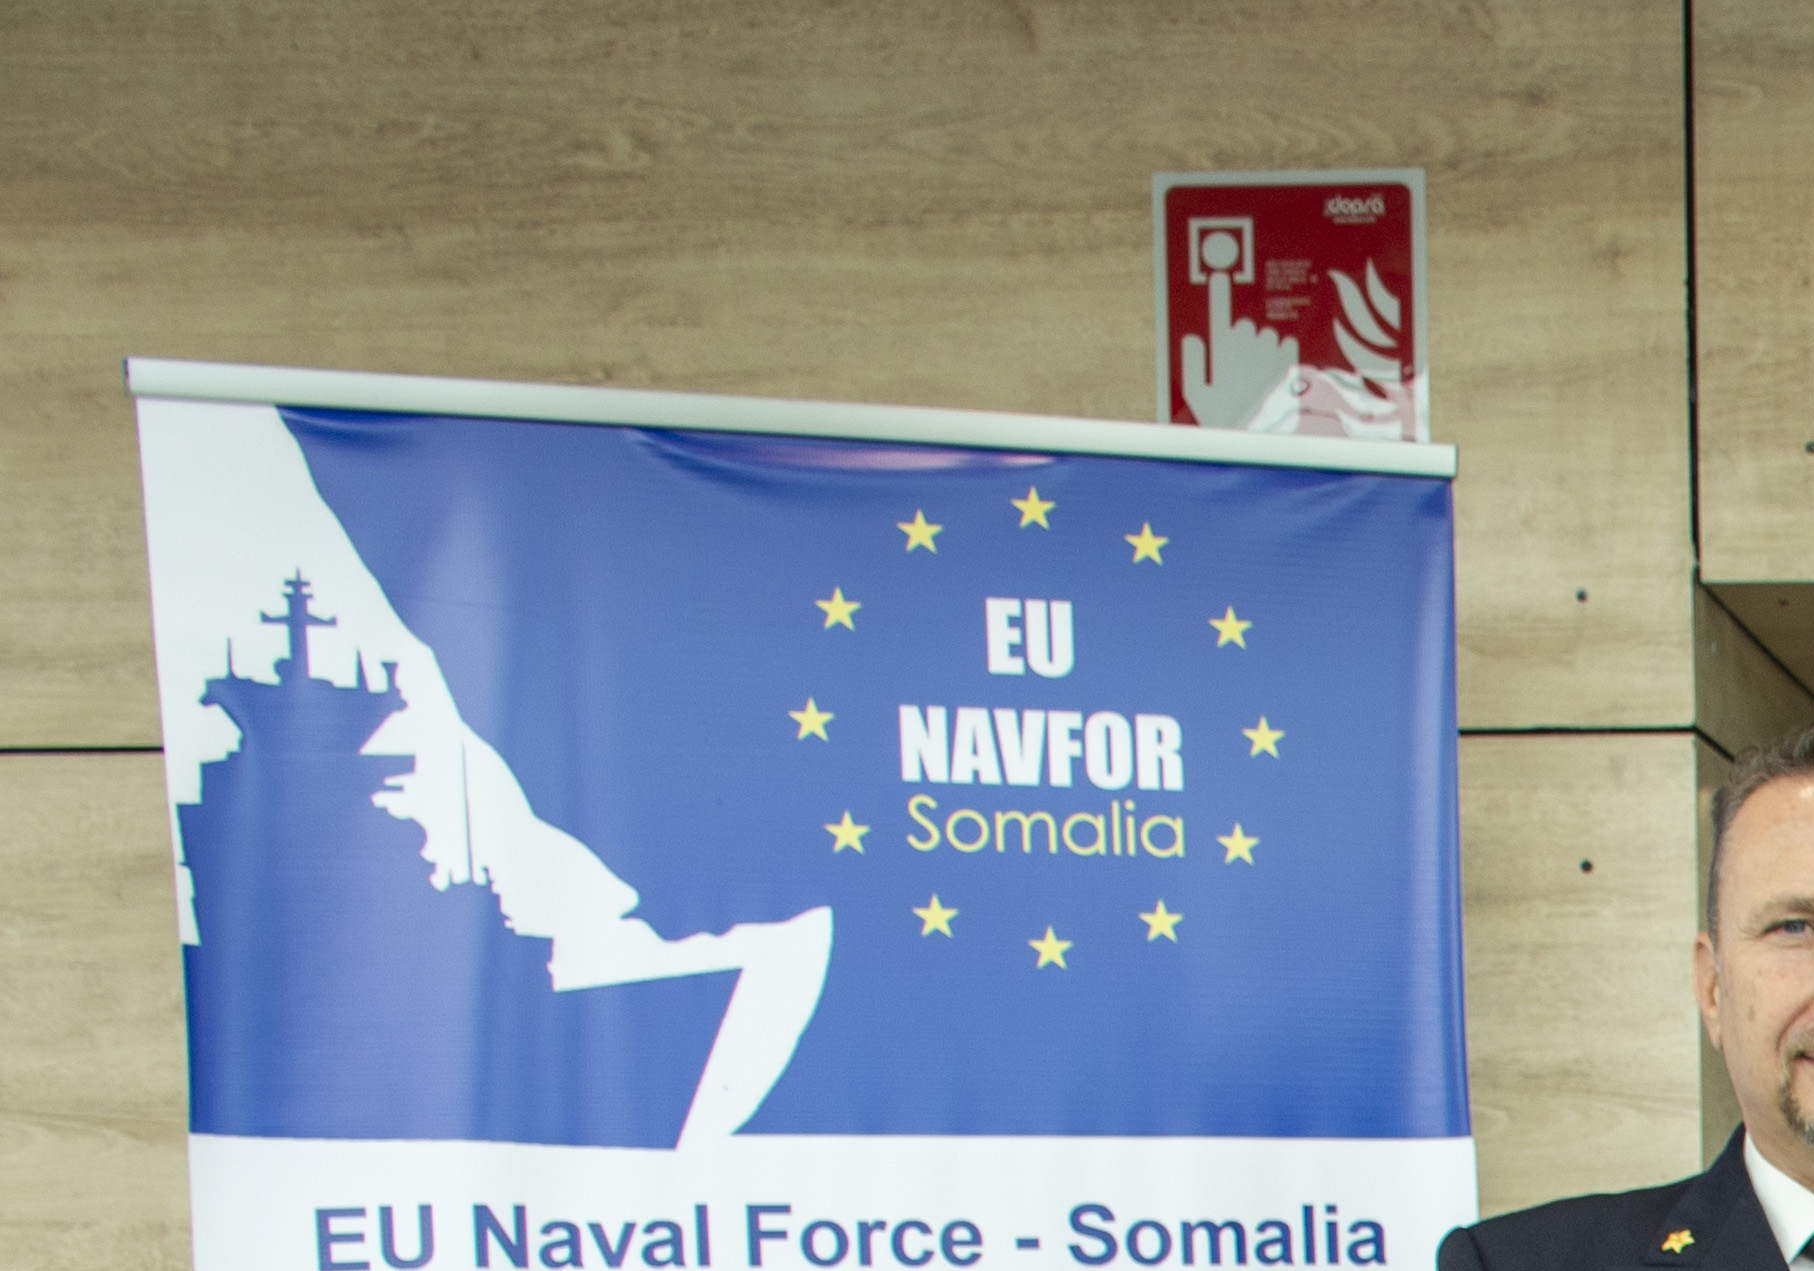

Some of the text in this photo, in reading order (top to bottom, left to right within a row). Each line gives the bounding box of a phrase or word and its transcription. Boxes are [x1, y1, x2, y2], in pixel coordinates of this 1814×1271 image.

[984, 596, 1075, 679] EU
[898, 704, 1184, 791] NAVFOR
[906, 794, 1186, 859] Somalia
[472, 1203, 711, 1270] Naval
[745, 1203, 984, 1269] Force
[1015, 1237, 1041, 1251] -
[1067, 1202, 1388, 1268] Somalia
